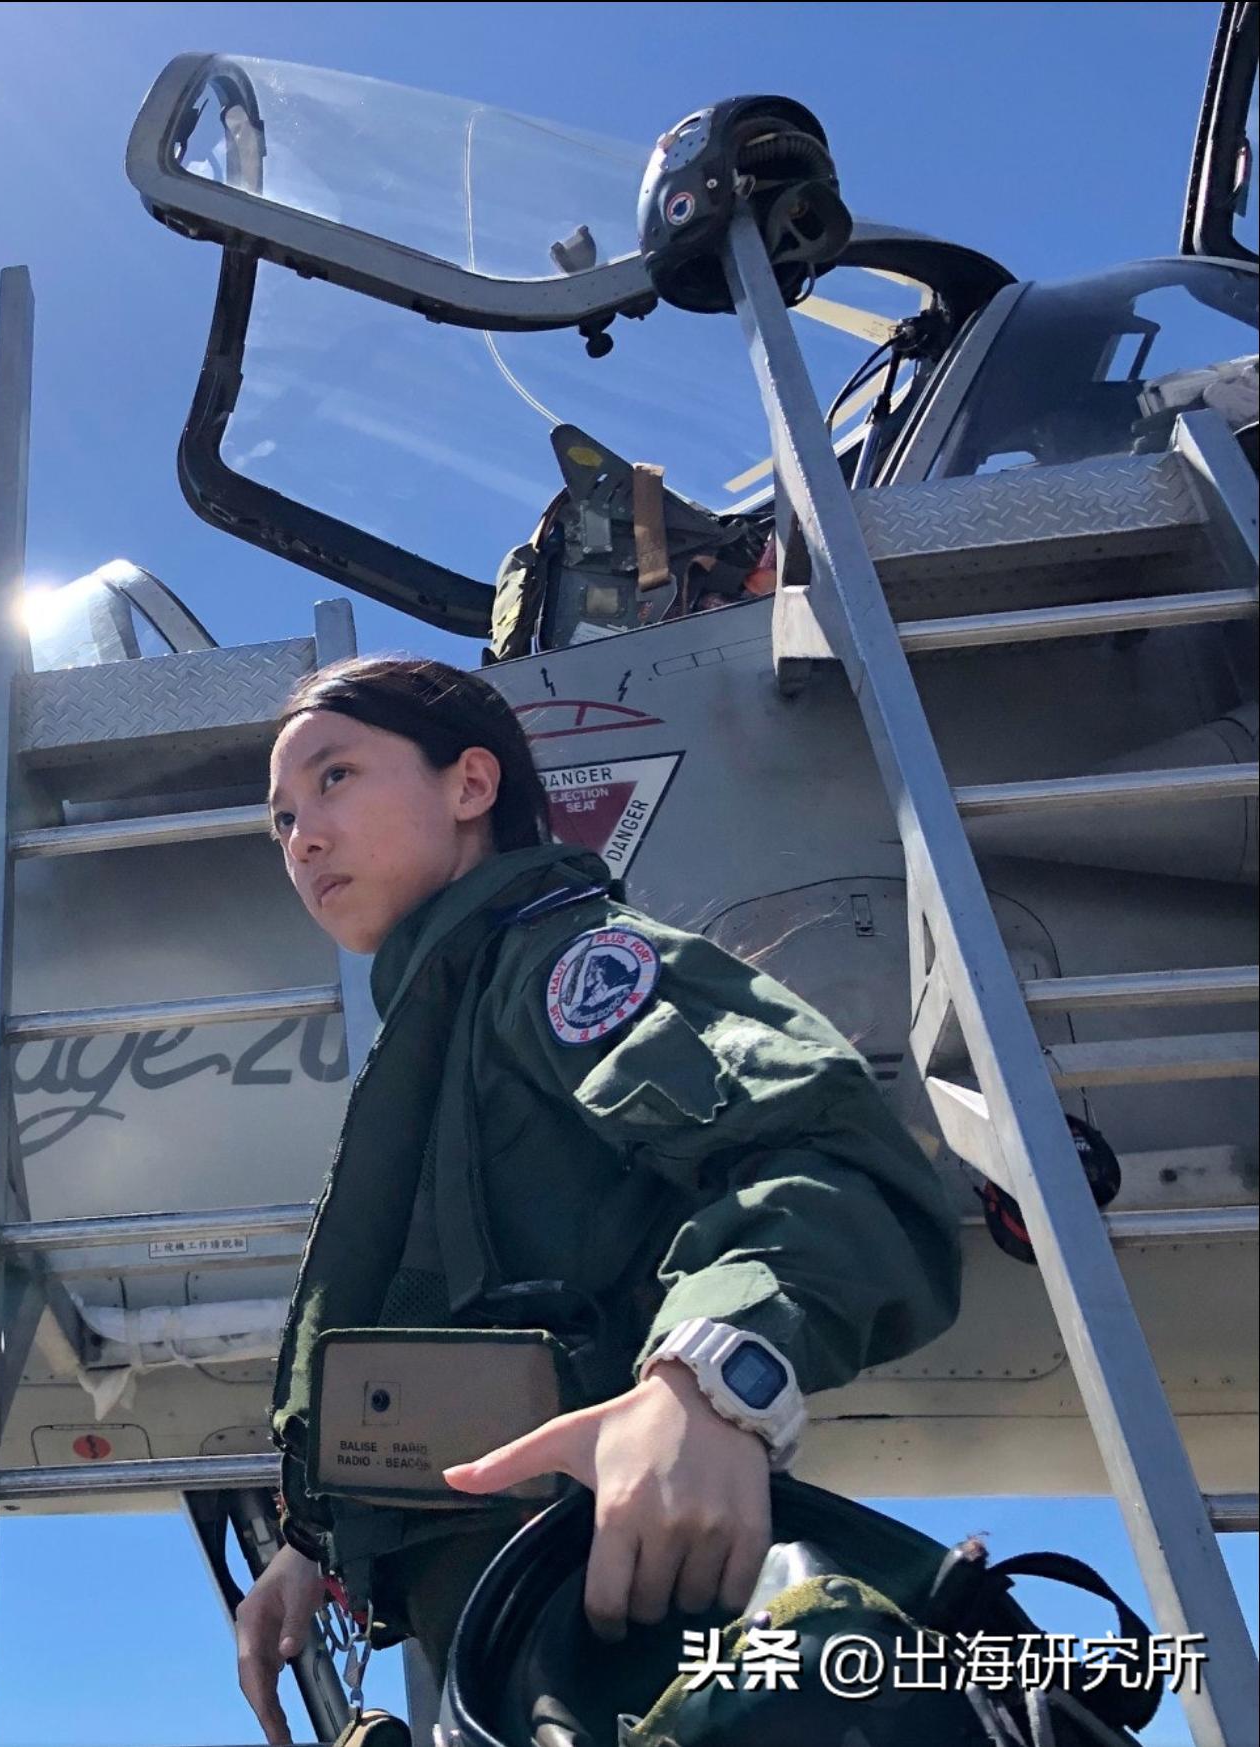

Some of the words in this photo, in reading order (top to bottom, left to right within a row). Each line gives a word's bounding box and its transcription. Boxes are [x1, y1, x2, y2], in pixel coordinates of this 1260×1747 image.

[540, 767, 613, 789] DANGER
[551, 787, 609, 803] EJECTION
[566, 801, 596, 813] SEAT
[606, 799, 649, 861] DANGER
[595, 933, 627, 944] PLUS
[630, 941, 652, 963] FORT
[549, 960, 567, 994] HAUT
[340, 1440, 377, 1452] BALISE
[337, 1455, 371, 1466] RADIO
